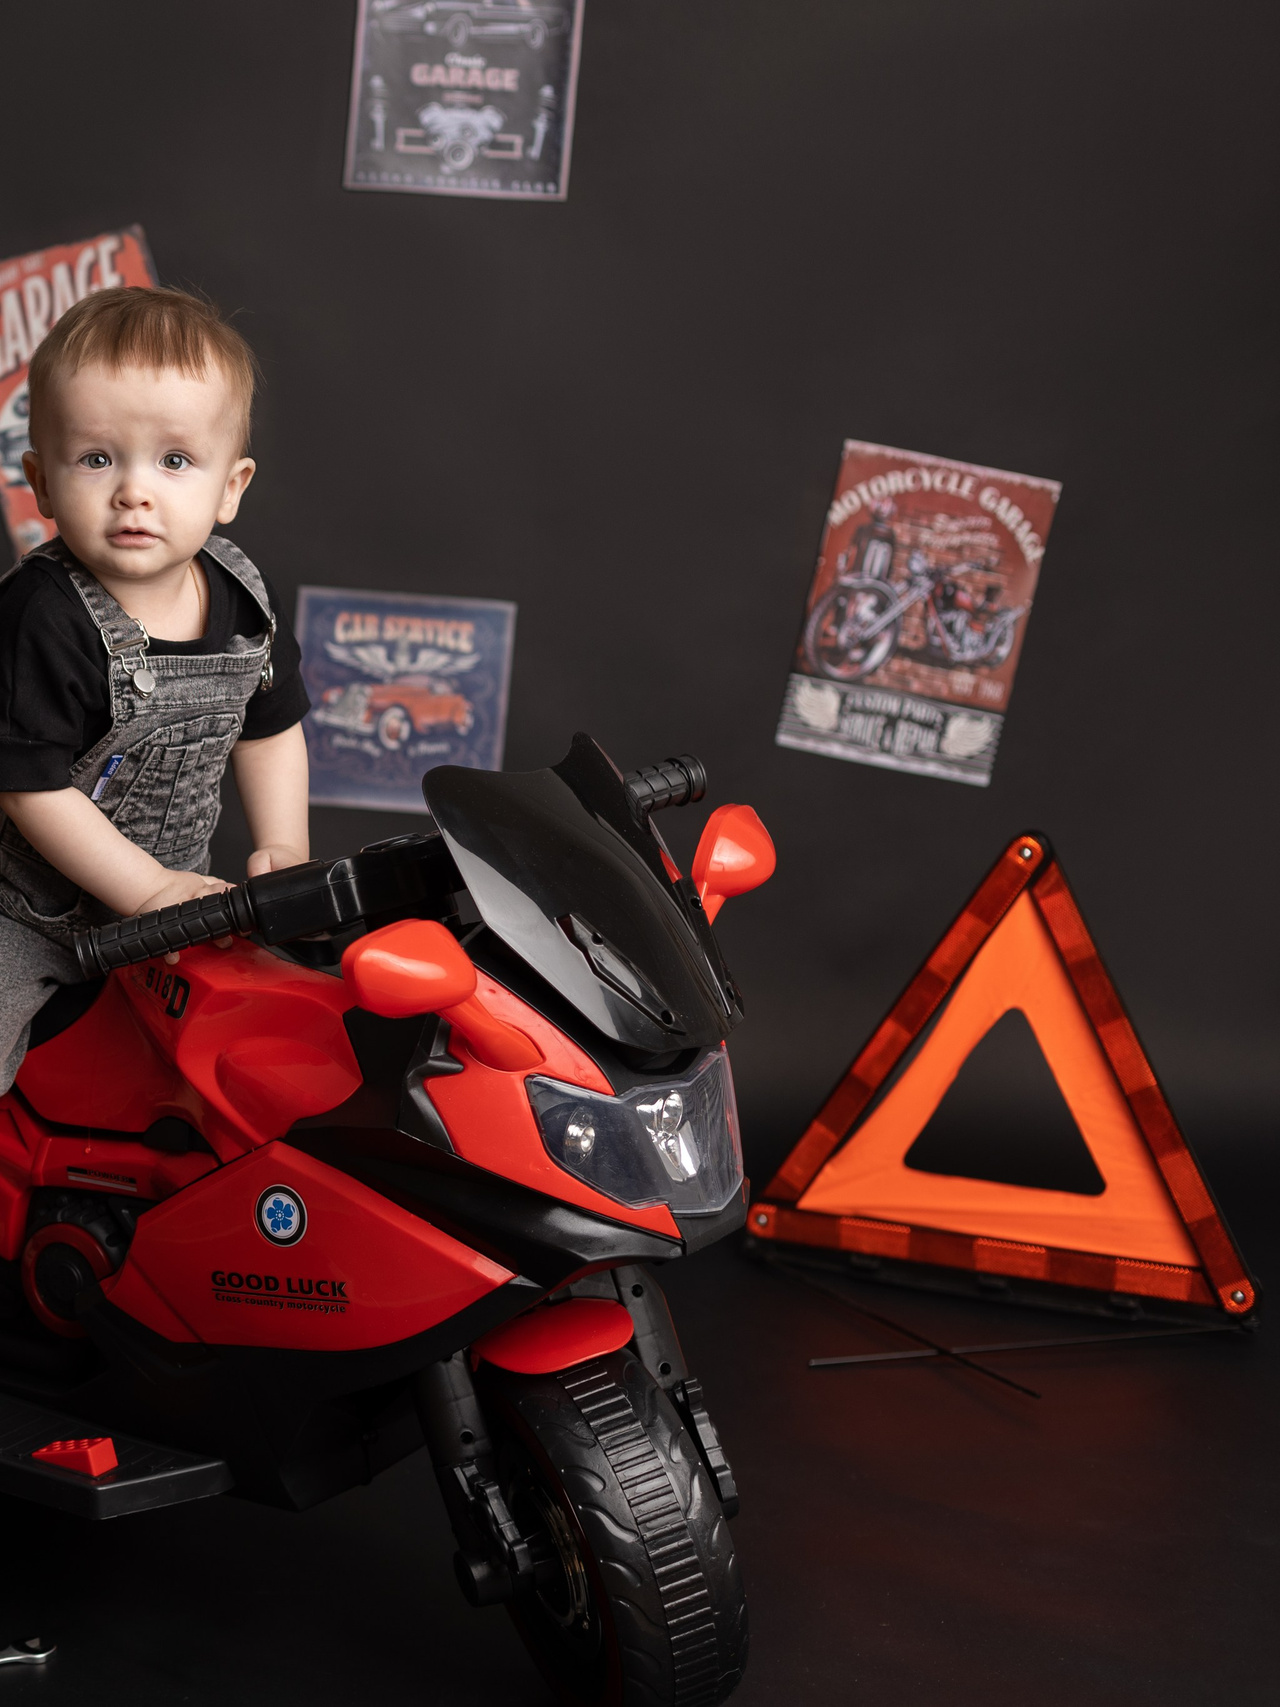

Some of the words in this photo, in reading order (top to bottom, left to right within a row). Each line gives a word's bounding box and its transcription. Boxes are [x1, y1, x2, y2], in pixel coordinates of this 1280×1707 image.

[410, 63, 519, 91] GARAGE
[827, 467, 980, 528] MOTORCYCLE
[978, 486, 1045, 563] GARAGE
[334, 611, 379, 644] CAR
[382, 615, 475, 654] SERVICE
[211, 1270, 280, 1292] GOOD
[286, 1277, 348, 1298] LUCK
[286, 1302, 346, 1315] motorcycle
